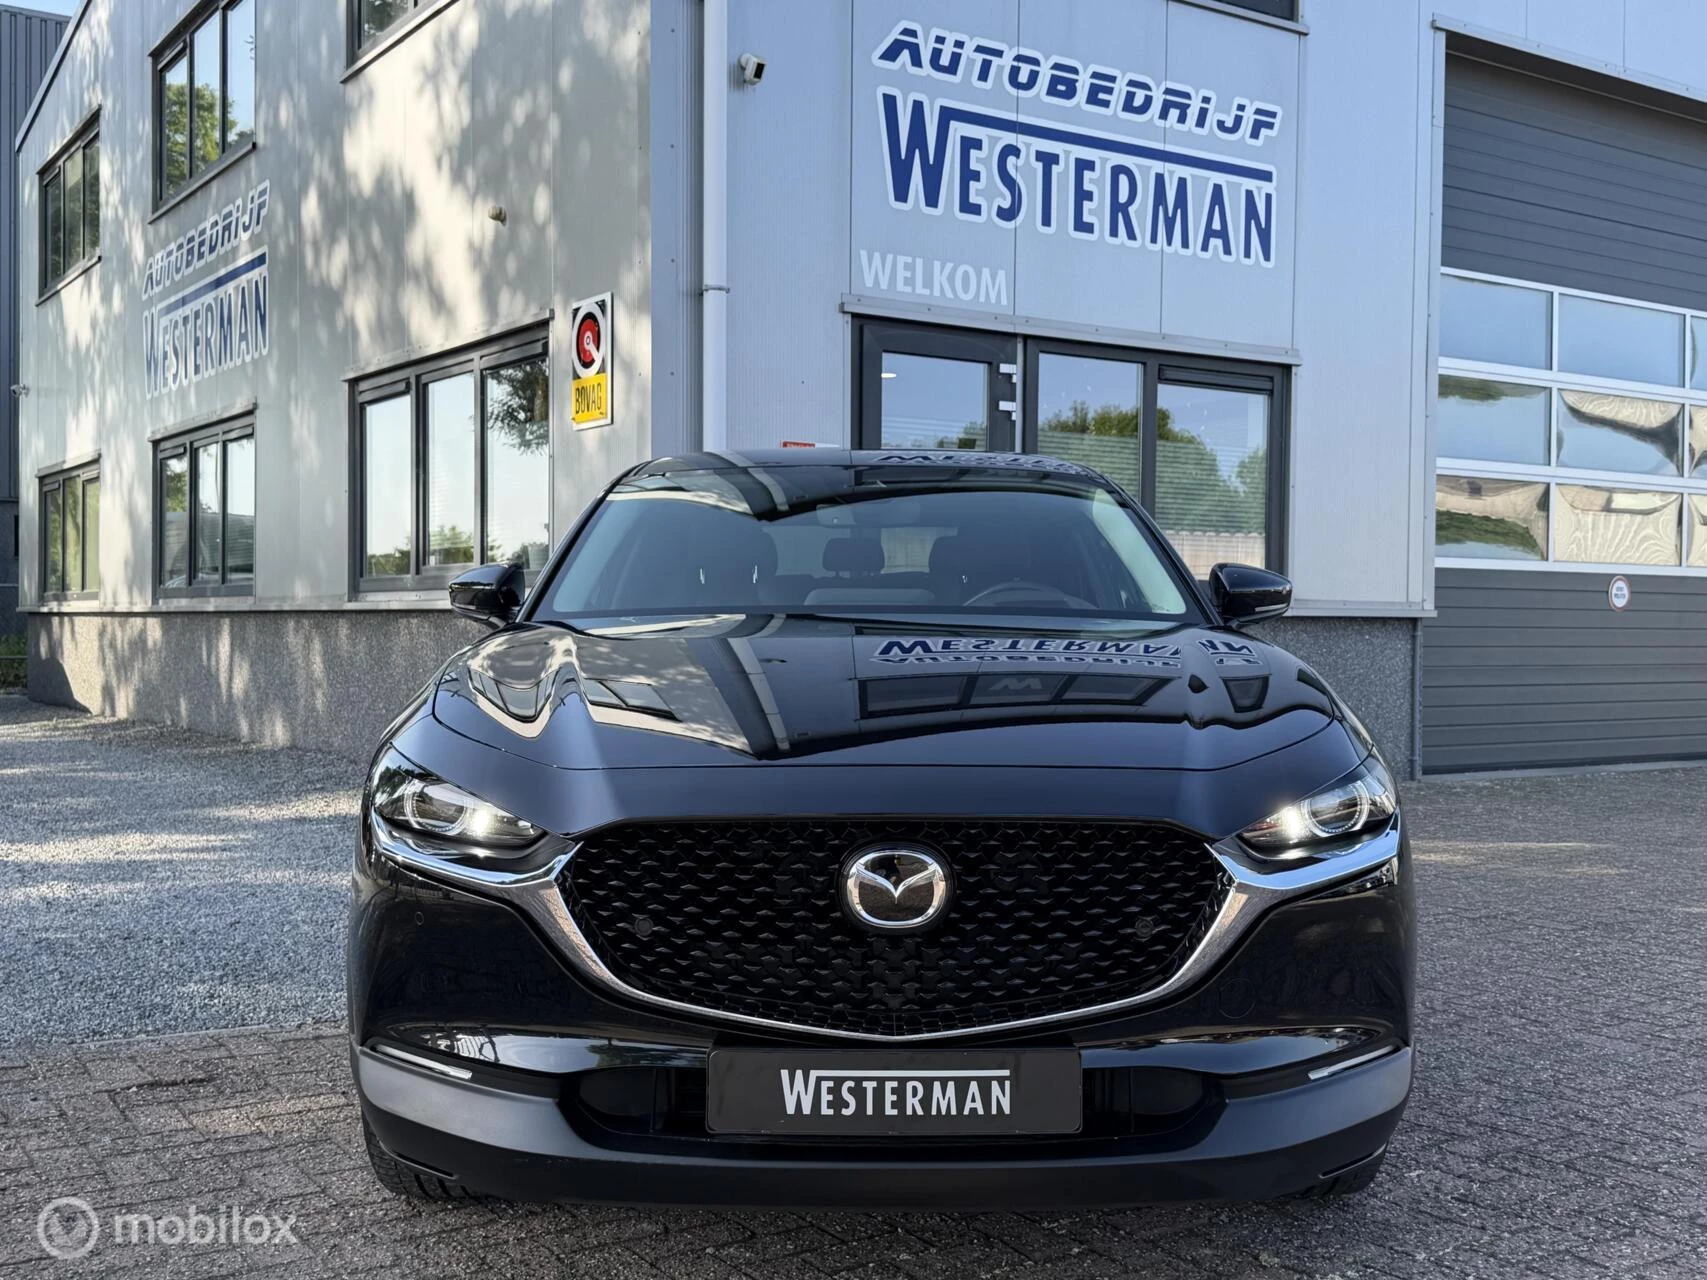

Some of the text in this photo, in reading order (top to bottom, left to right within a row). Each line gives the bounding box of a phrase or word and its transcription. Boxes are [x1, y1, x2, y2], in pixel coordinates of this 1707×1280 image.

[876, 25, 1279, 141] AUTOBEDRIJF
[881, 92, 1274, 263] WESTERMAN
[143, 184, 269, 297] AUTOBEDRIJF
[859, 248, 1008, 305] WELKOM
[143, 251, 268, 398] WESTERMAN
[574, 383, 603, 415] BOVAG
[780, 1069, 1011, 1116] WESTERMAN
